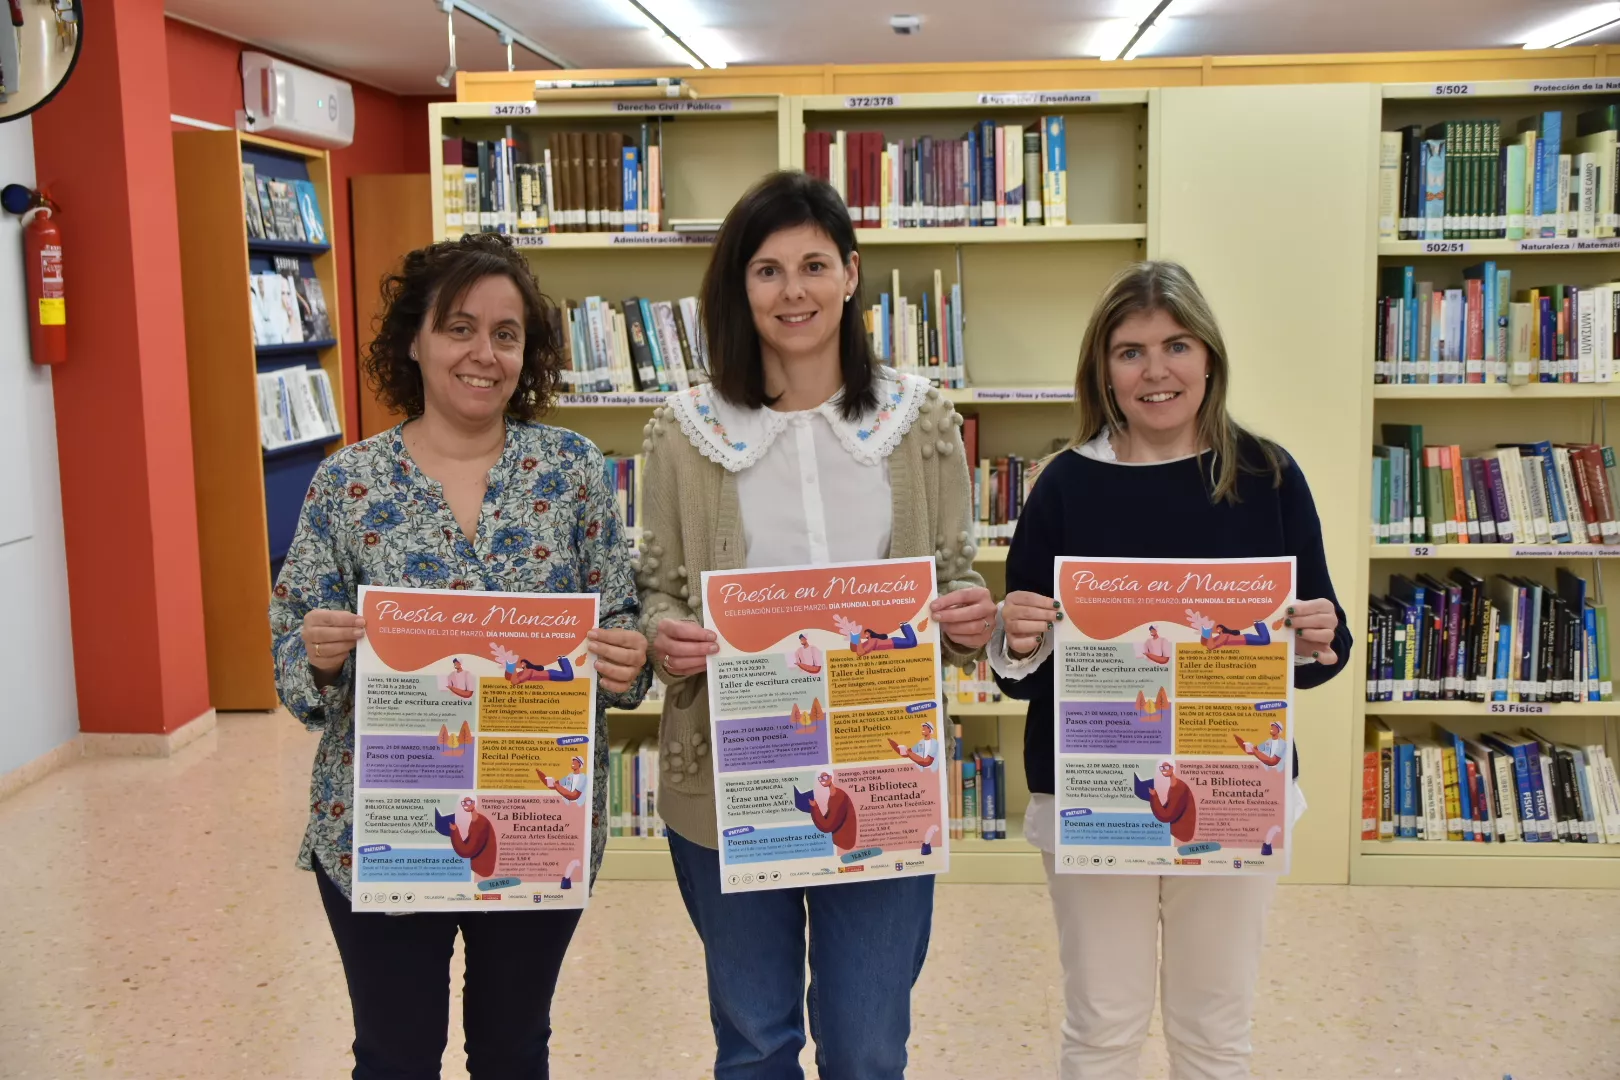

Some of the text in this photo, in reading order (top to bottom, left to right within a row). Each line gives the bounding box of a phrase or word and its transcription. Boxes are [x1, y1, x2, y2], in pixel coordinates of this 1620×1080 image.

[1436, 86, 1468, 94] 5/502
[850, 98, 894, 107] 372/378
[1040, 94, 1090, 102] Enseñanza
[495, 106, 530, 114] 347/35
[687, 102, 721, 110] Público
[602, 396, 635, 404] Trabajo
[1072, 571, 1276, 593] Poesía en Monzón
[720, 574, 918, 603] Poesía en Monzón
[829, 601, 840, 610] DÍA
[841, 600, 870, 609] MUNDIAL
[892, 597, 916, 605] POESÍA
[376, 600, 580, 626] Poesía en Monzón
[486, 630, 498, 638] DÍA
[866, 666, 905, 675] ilustración
[756, 678, 788, 686] escritura
[869, 782, 917, 791] Biblioteca
[1211, 778, 1261, 786] Biblioteca
[512, 812, 562, 820] Biblioteca
